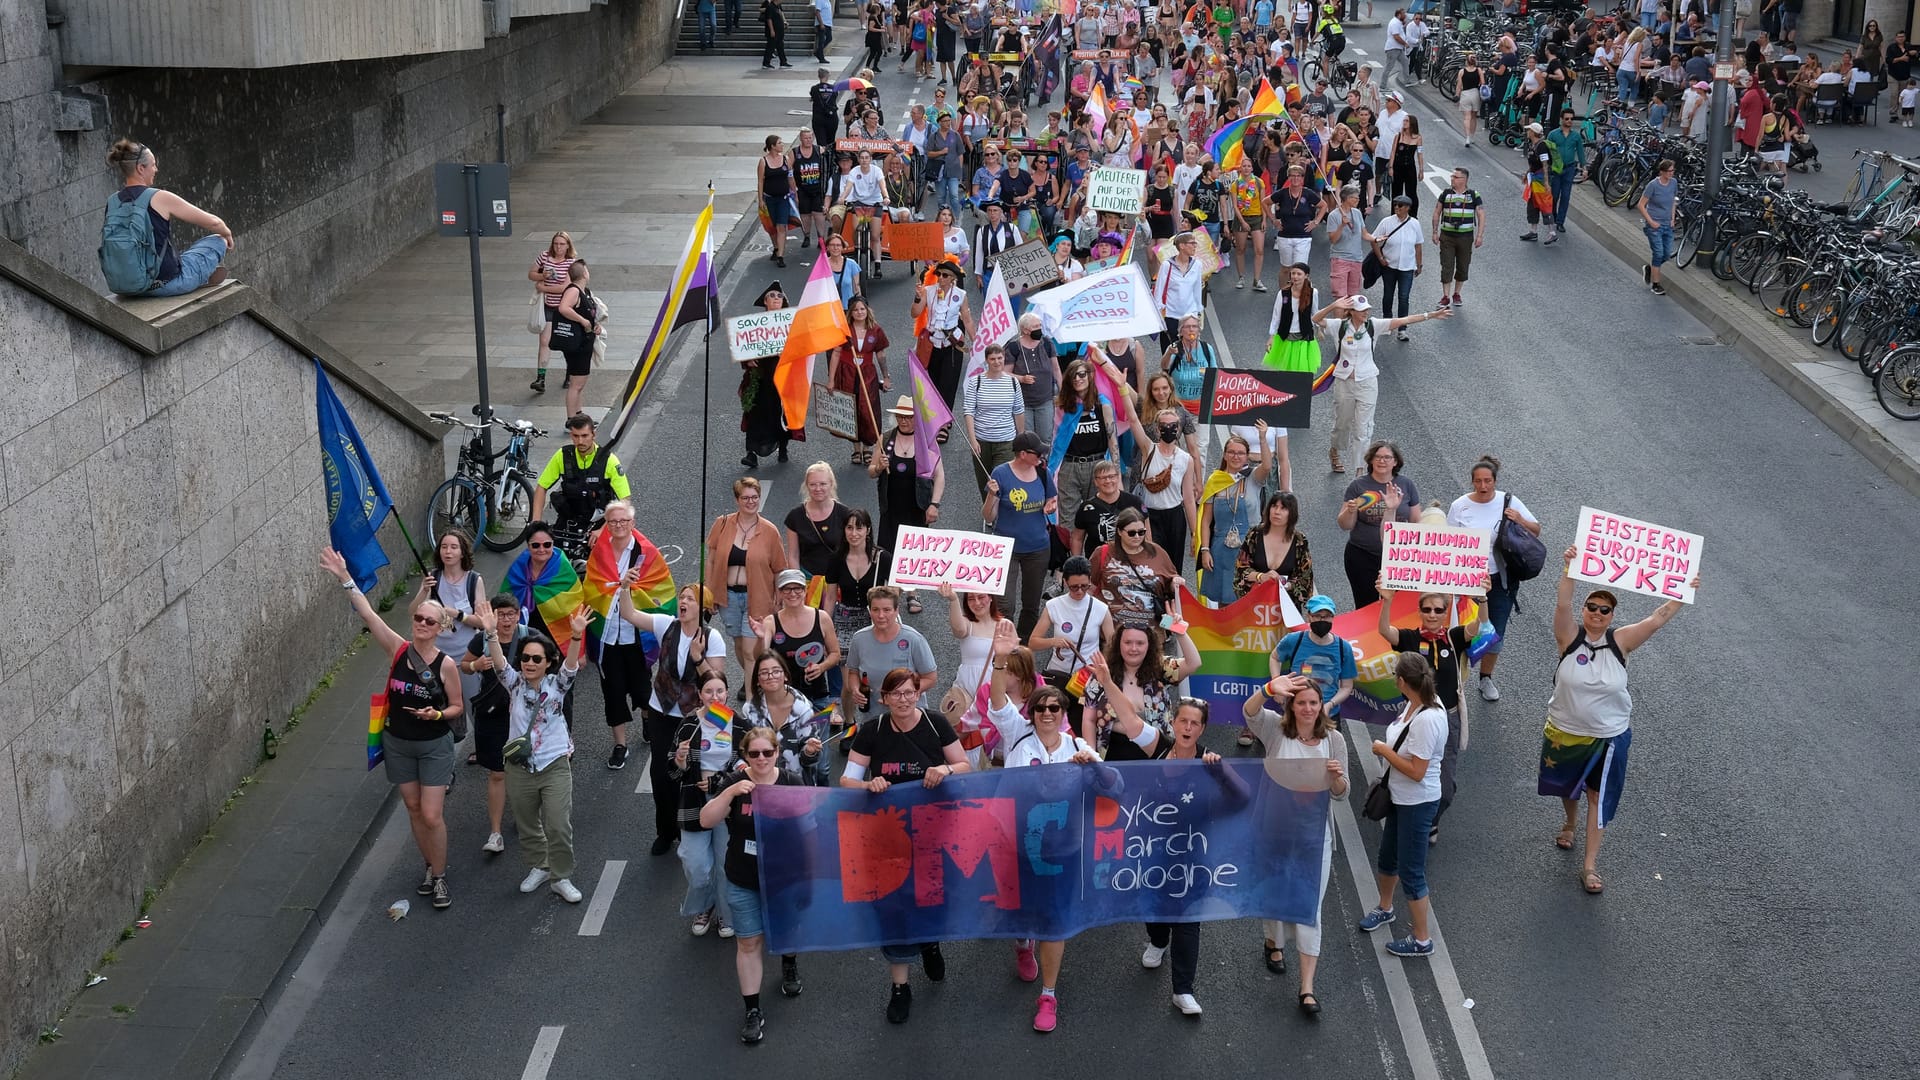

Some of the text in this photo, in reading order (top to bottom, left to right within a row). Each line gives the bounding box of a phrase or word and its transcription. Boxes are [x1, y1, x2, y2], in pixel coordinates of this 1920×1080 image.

[1095, 170, 1140, 185] MEUTEREI
[1098, 185, 1132, 196] AUF DER
[1092, 195, 1137, 211] LINDNER
[990, 250, 1018, 263] VOLLE
[999, 247, 1046, 272] BREITSEITE
[1003, 266, 1029, 281] GEGEN
[737, 313, 792, 329] save the
[740, 339, 786, 352] ARTENSCHU
[757, 347, 783, 356] JETZ
[1218, 376, 1260, 390] WOMEN
[1215, 391, 1270, 411] SUPPORTING
[1398, 529, 1421, 546] AM
[1424, 532, 1480, 549] HUMAN
[1590, 513, 1691, 555] EASTERN
[902, 533, 1005, 559] HAPPY PRIDE
[1586, 534, 1690, 575] EUROPEAN
[1388, 547, 1489, 569] NOTHING MORE
[896, 557, 1003, 587] EVERY DAY!
[1386, 566, 1422, 582] THEN
[1581, 552, 1686, 600] DYKE
[1253, 604, 1282, 626] SIS
[1232, 629, 1280, 651] STAN
[1213, 681, 1248, 697] LGBTI
[1094, 824, 1208, 861] March
[837, 798, 1070, 910] DMC
[1093, 859, 1238, 898] Cologne
